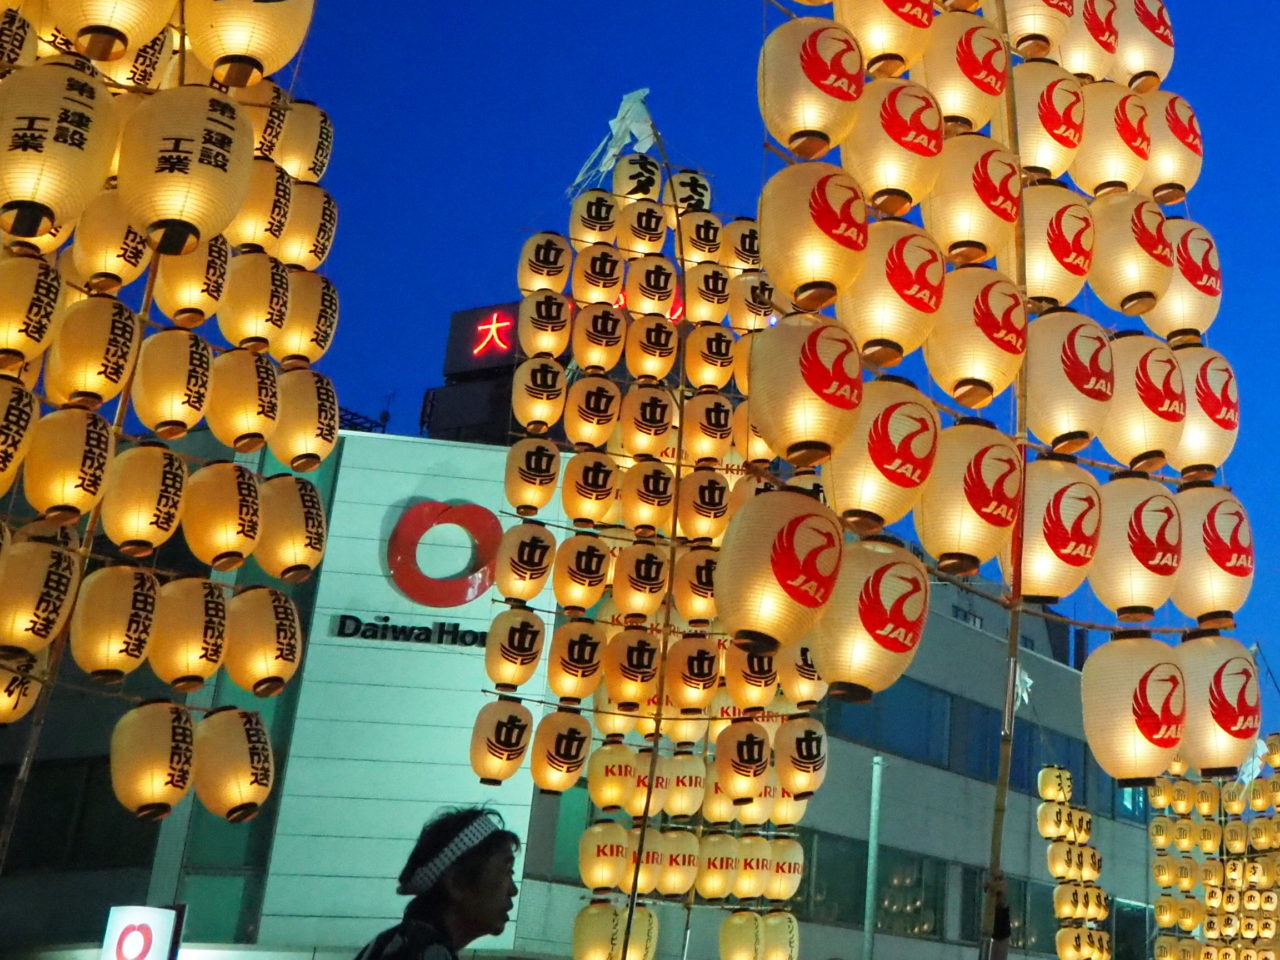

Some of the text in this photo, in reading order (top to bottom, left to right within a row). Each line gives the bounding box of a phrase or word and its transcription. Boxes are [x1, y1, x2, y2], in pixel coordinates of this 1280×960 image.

[898, 3, 930, 26] JAL
[820, 74, 858, 98] JAL
[974, 70, 1003, 94] JAL
[53, 77, 96, 151] 第一建設
[8, 116, 51, 153] 工業
[198, 98, 236, 172] 第一建設
[902, 131, 938, 153] JAL
[1053, 124, 1081, 145] JAL
[155, 137, 195, 174] 工業
[991, 195, 1019, 219] JAL
[831, 222, 865, 247] JAL
[1063, 251, 1091, 272] JAL
[265, 257, 289, 328] 秋田放送
[1197, 274, 1221, 291] JAL
[904, 283, 938, 310] JAL
[97, 303, 134, 383] 秋田放送
[473, 312, 511, 355] 大
[993, 329, 1024, 353] JAL
[182, 335, 209, 411] 秋田放送
[252, 352, 277, 420] 秋田放送
[823, 380, 860, 405] JAL
[1083, 376, 1113, 397] JAL
[313, 373, 335, 442] 秋田放送
[1158, 399, 1185, 416] JAL
[1216, 405, 1239, 423] JAL
[75, 413, 109, 496] 秋田放送
[883, 458, 923, 484] JAL
[149, 452, 185, 532] 秋田放送
[235, 466, 260, 539] 秋田放送
[981, 500, 1016, 522] JAL
[1060, 541, 1095, 559] JAL
[1148, 551, 1179, 567] JAL
[1225, 553, 1253, 568] JAL
[24, 549, 73, 639] 秋田放送
[787, 574, 824, 603] JAL
[118, 572, 156, 659] 秋田放送
[199, 582, 226, 663] 秋田放送
[269, 590, 296, 663] 秋田放送
[876, 623, 915, 648] JAL
[1231, 715, 1259, 731] JAL
[165, 707, 193, 790] 秋田放送
[239, 711, 270, 787] 秋田放送
